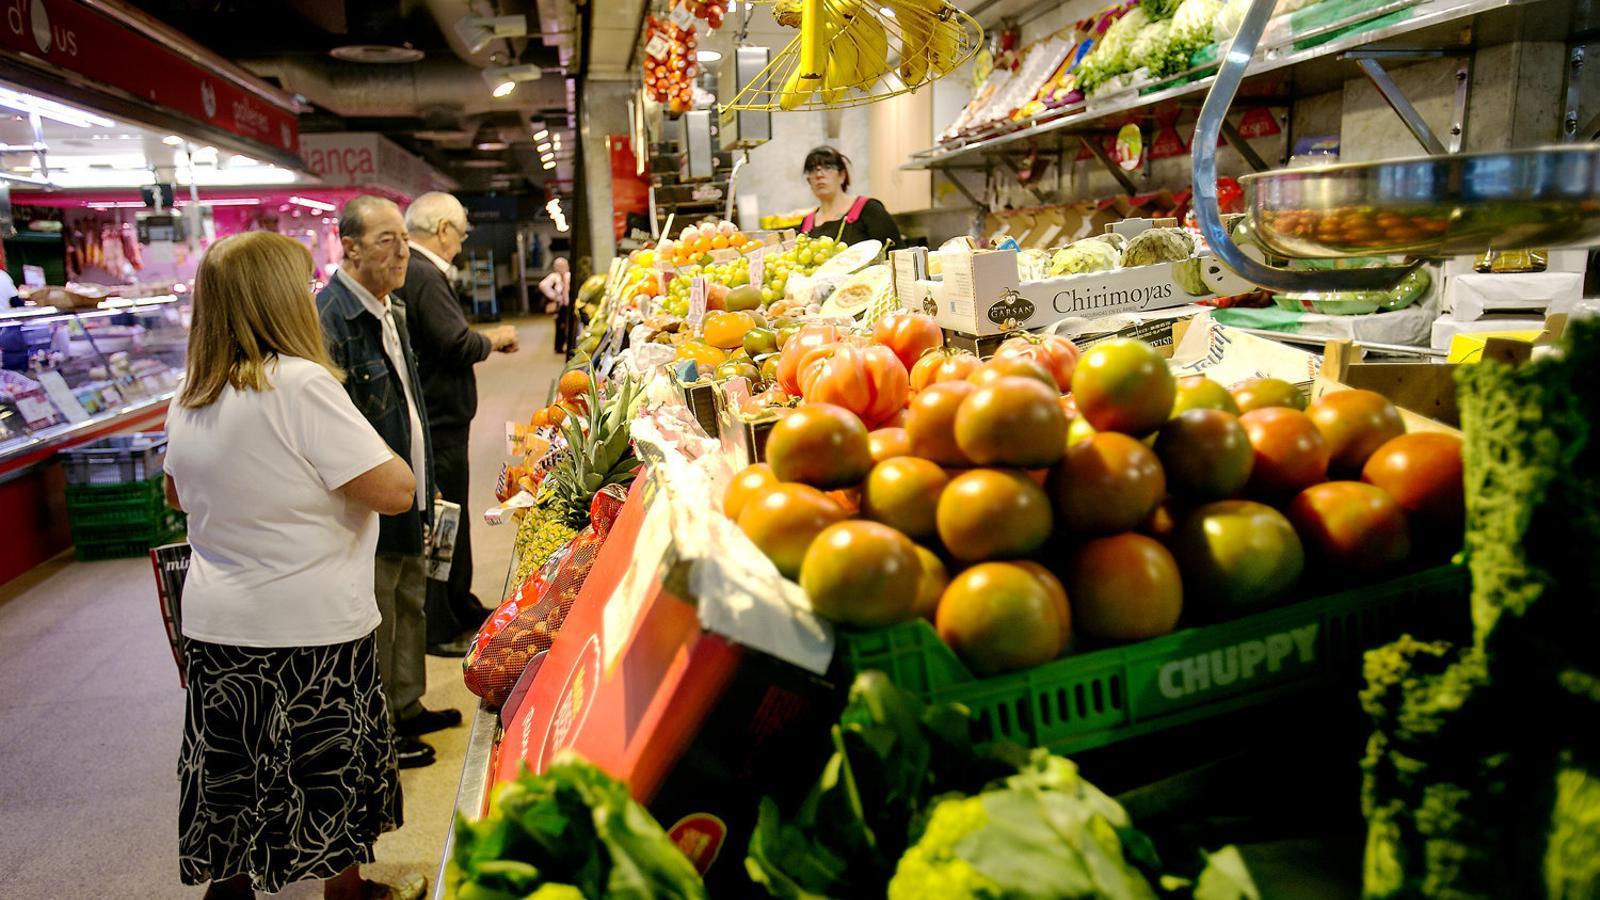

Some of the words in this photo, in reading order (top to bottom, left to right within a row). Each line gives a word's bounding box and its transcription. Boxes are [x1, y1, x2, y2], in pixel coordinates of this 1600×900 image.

[991, 306, 1031, 318] GARSAN
[1052, 283, 1172, 314] Chirimoyas
[1158, 623, 1319, 699] CHUPPY
